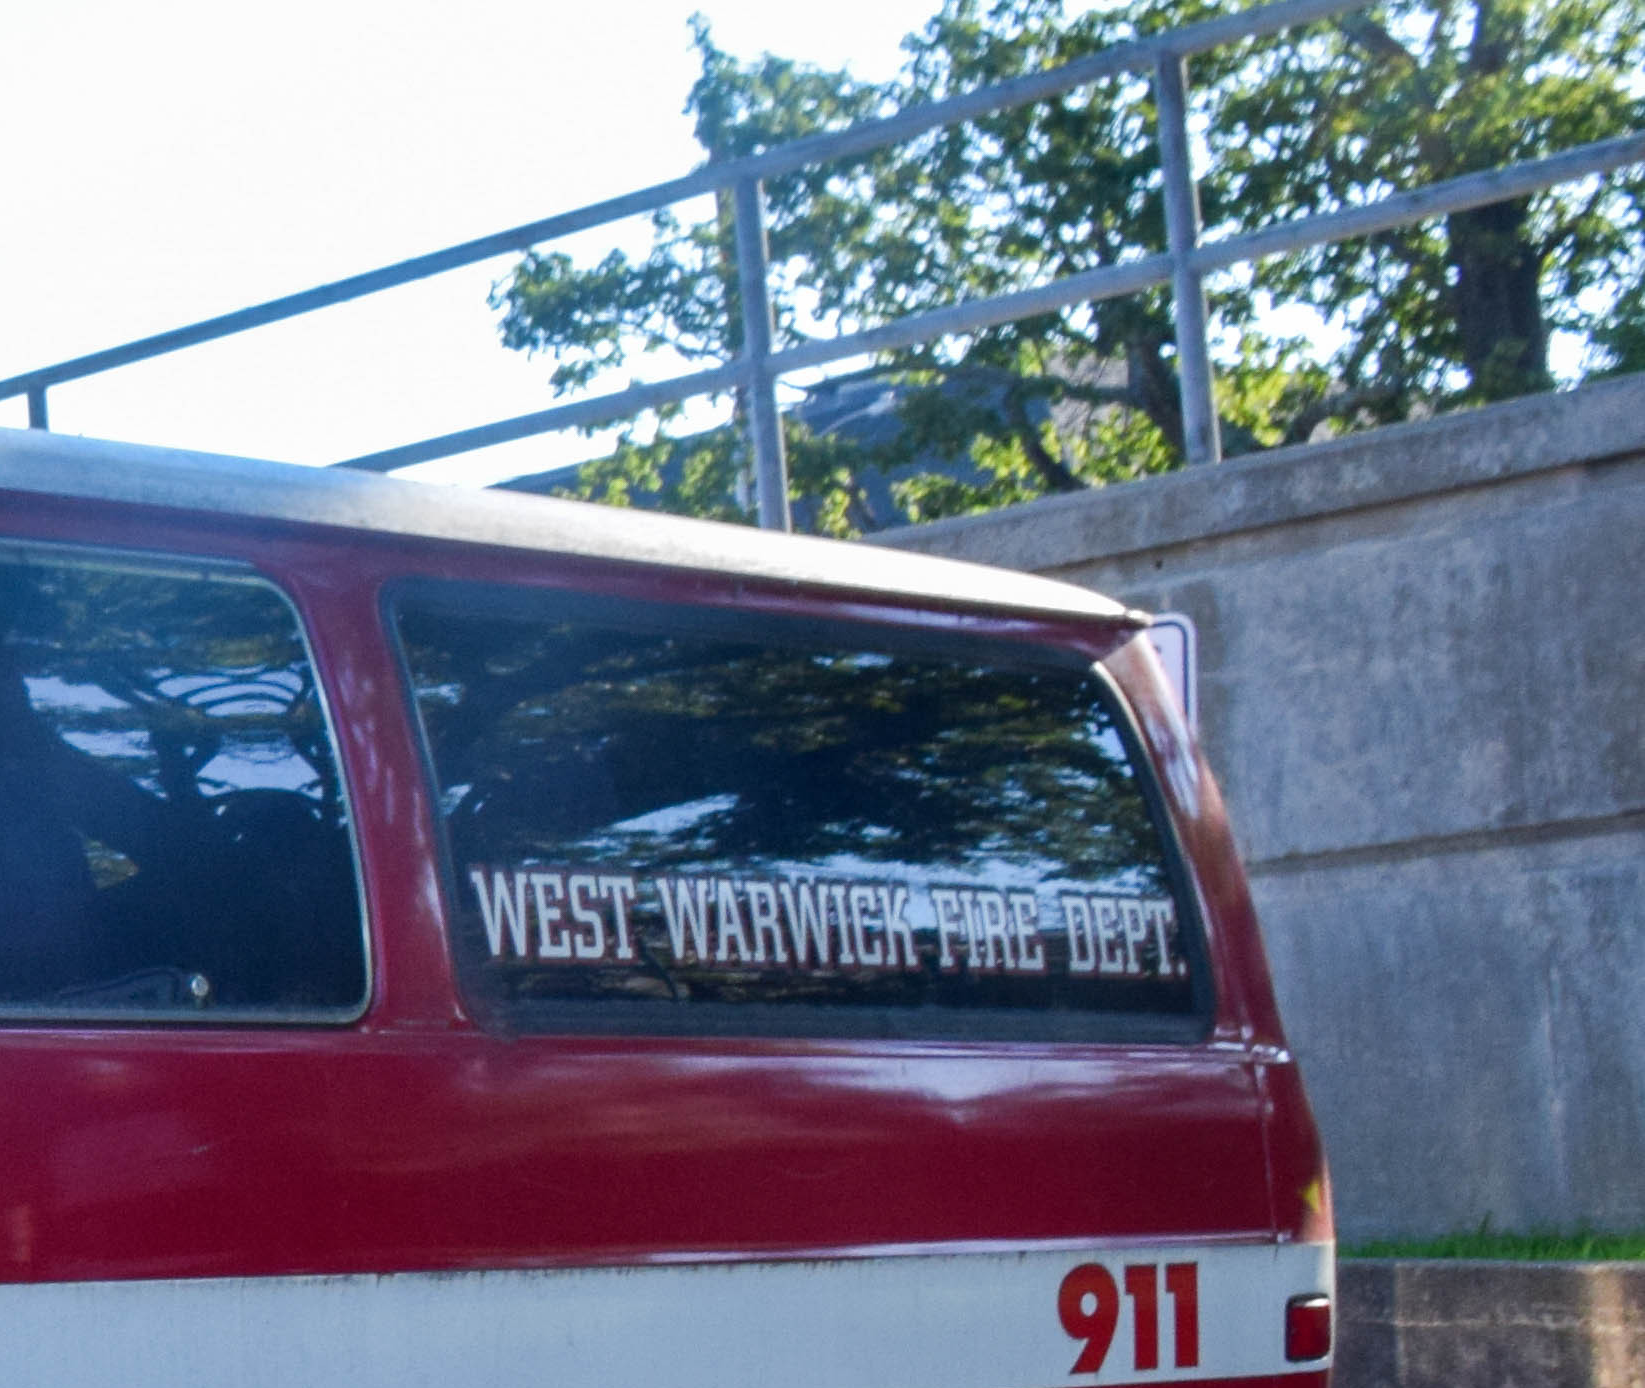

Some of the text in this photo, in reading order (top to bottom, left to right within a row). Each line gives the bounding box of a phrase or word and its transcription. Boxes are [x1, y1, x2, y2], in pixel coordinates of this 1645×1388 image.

[471, 870, 1188, 976] WEST WARWICK FIRE DEPT.
[1056, 1261, 1199, 1375] 911
